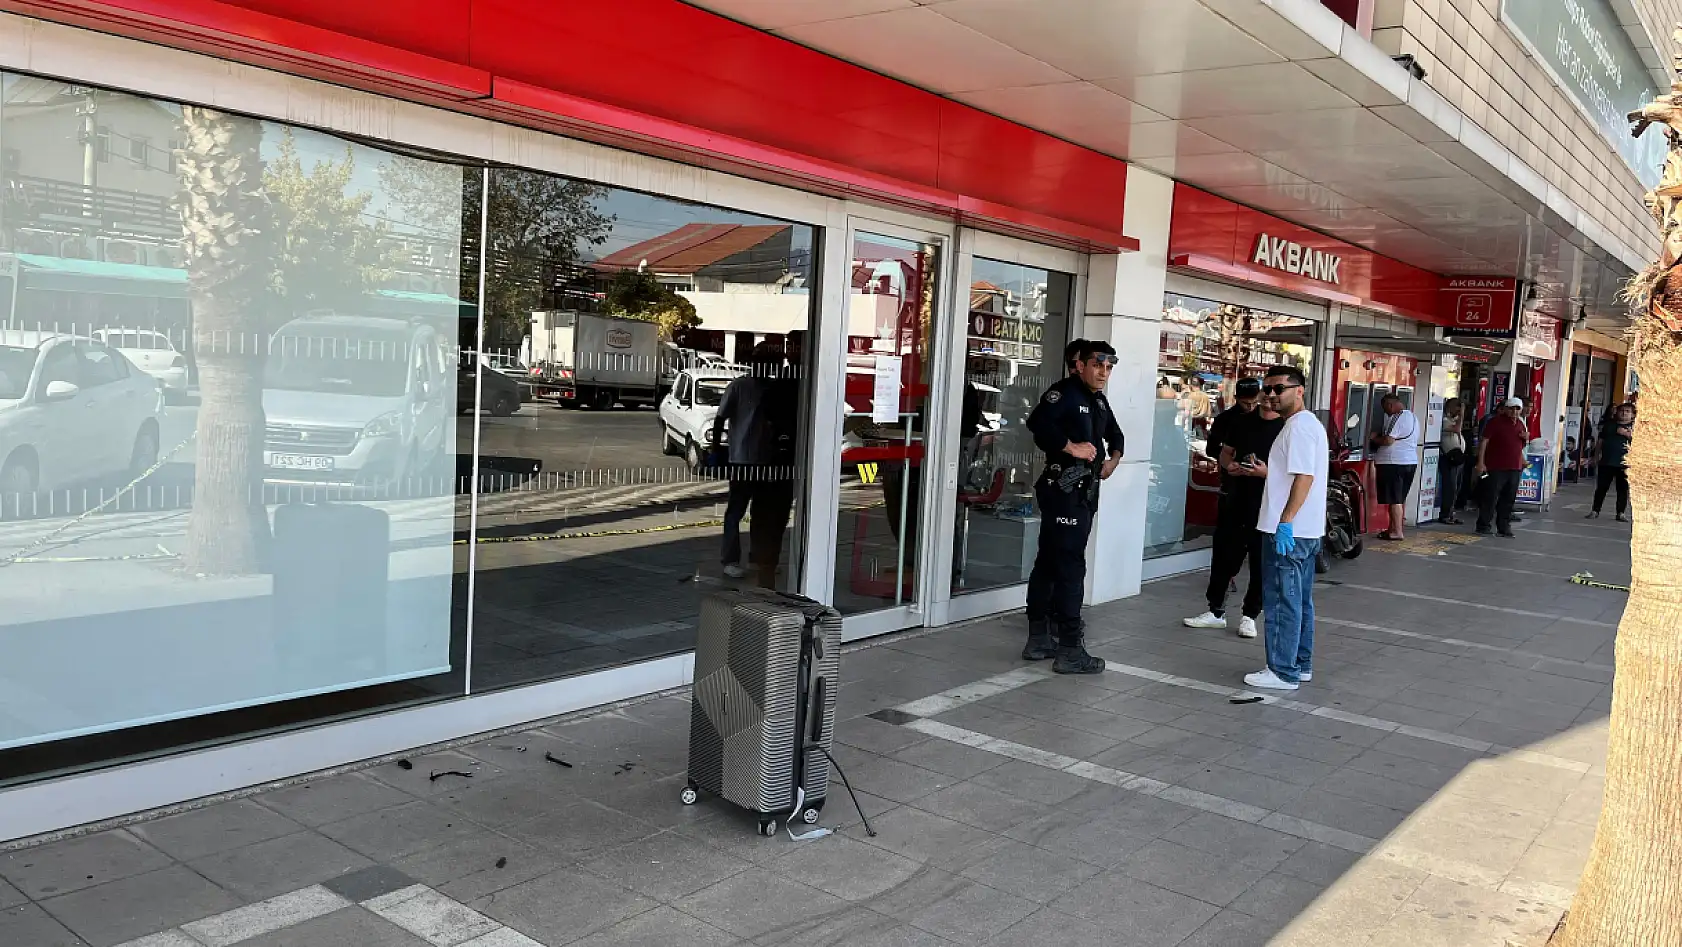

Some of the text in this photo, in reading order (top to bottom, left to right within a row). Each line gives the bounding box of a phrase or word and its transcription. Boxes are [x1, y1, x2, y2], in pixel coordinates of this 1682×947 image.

[1254, 233, 1342, 284] AKBANK
[1450, 279, 1504, 287] AKBANK
[1466, 312, 1480, 321] 24
